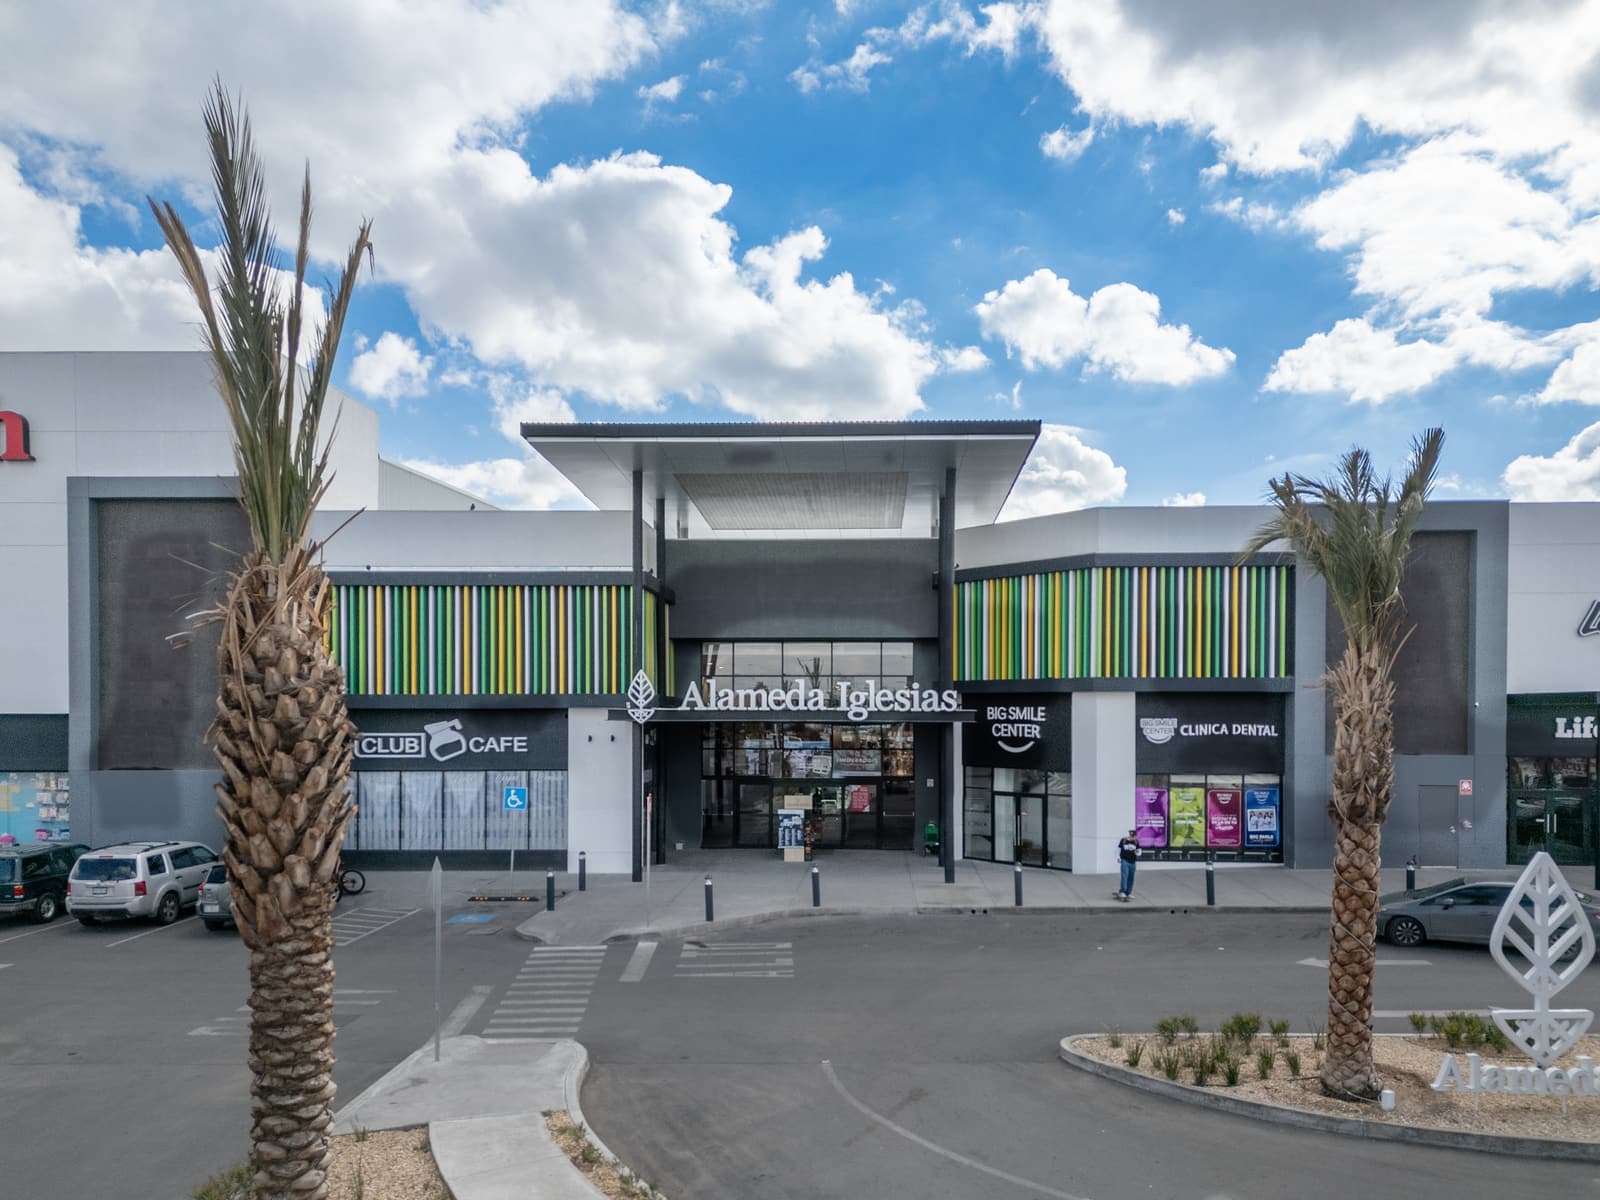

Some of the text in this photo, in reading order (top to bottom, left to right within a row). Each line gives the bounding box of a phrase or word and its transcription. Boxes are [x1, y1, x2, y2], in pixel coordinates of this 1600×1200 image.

[680, 679, 959, 721] Alameda Iglesias
[987, 706, 1046, 721] BIG SMILE
[992, 723, 1040, 738] CENTER
[1180, 724, 1278, 736] CLINICA DENTAL
[361, 736, 528, 753] CLUB CAFE
[1430, 1053, 1600, 1096] Alamed
